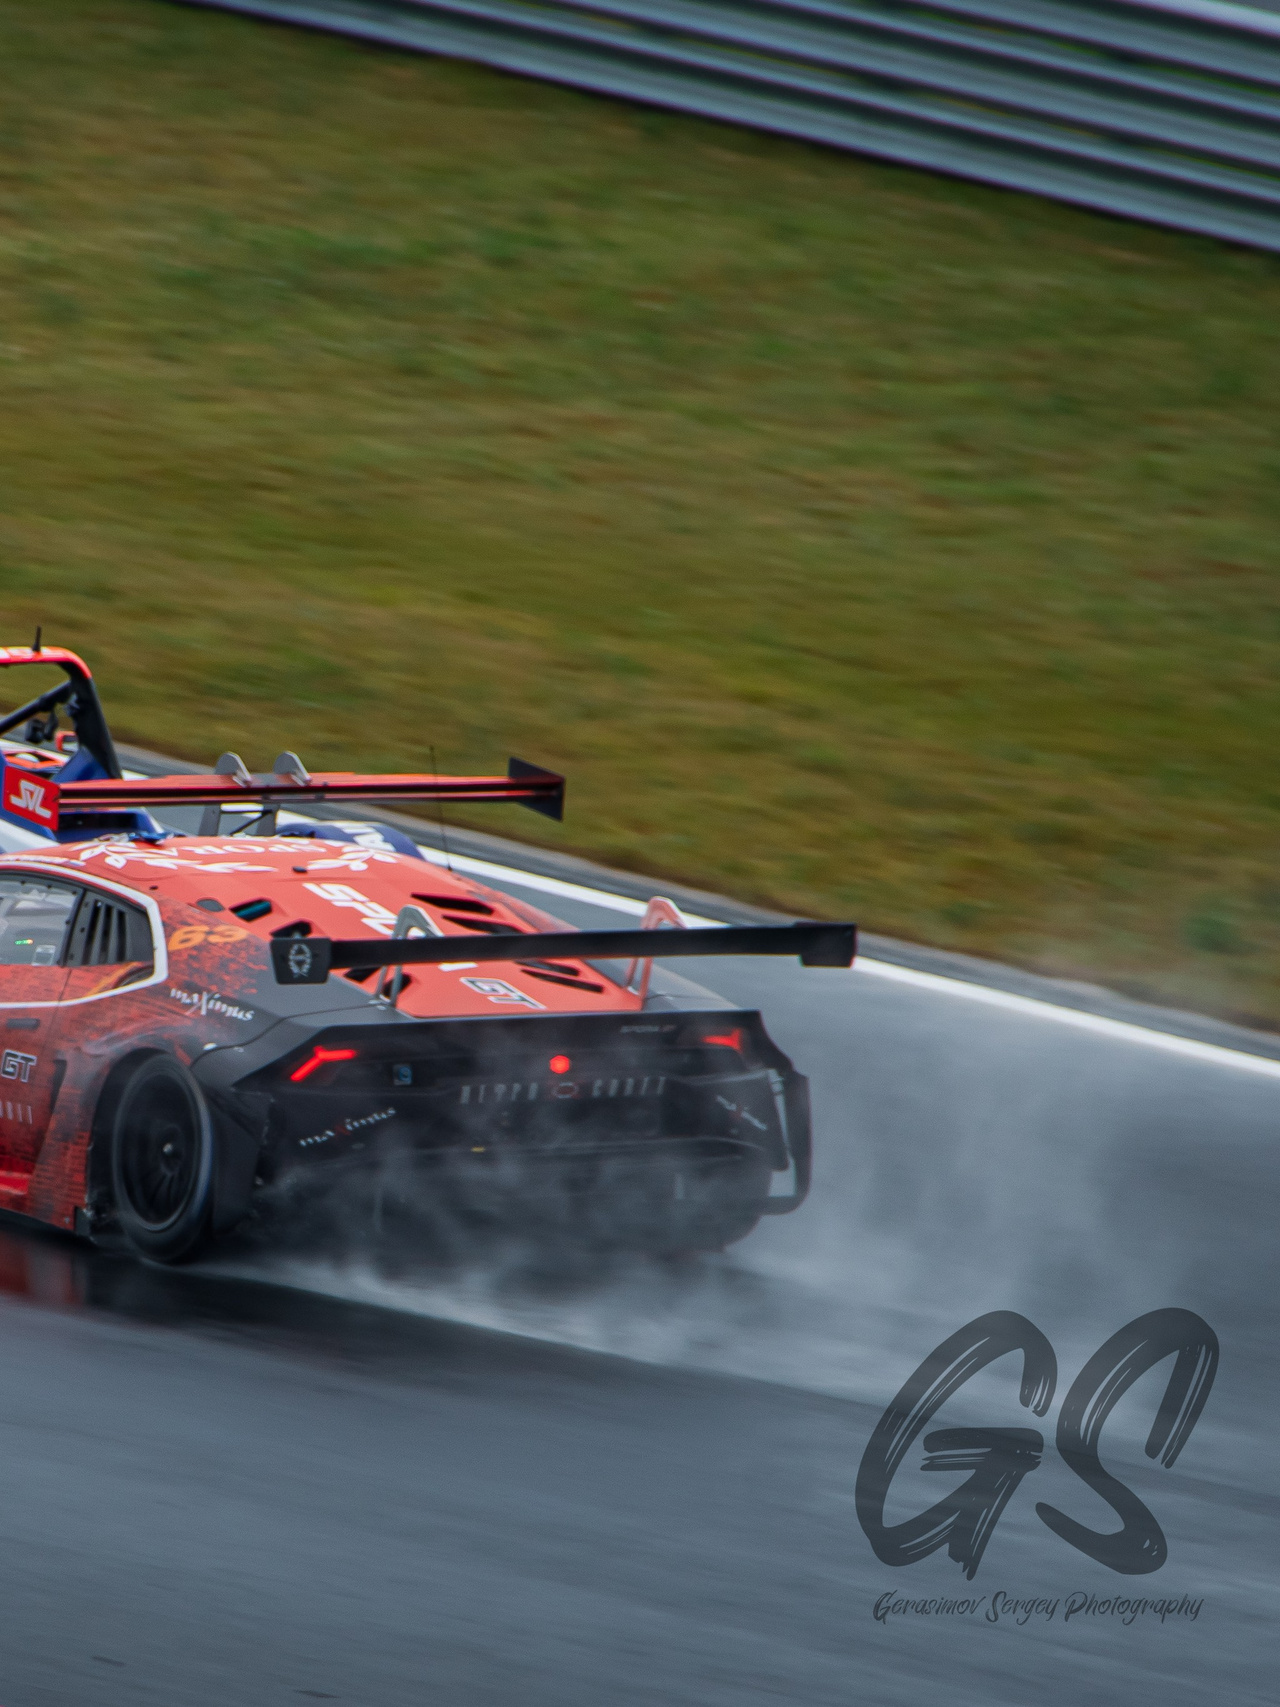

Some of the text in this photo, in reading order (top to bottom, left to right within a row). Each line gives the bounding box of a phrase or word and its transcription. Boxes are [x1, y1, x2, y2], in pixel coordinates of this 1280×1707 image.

[167, 925, 248, 950] 63
[460, 977, 547, 1010] GT
[0, 1049, 38, 1083] GT
